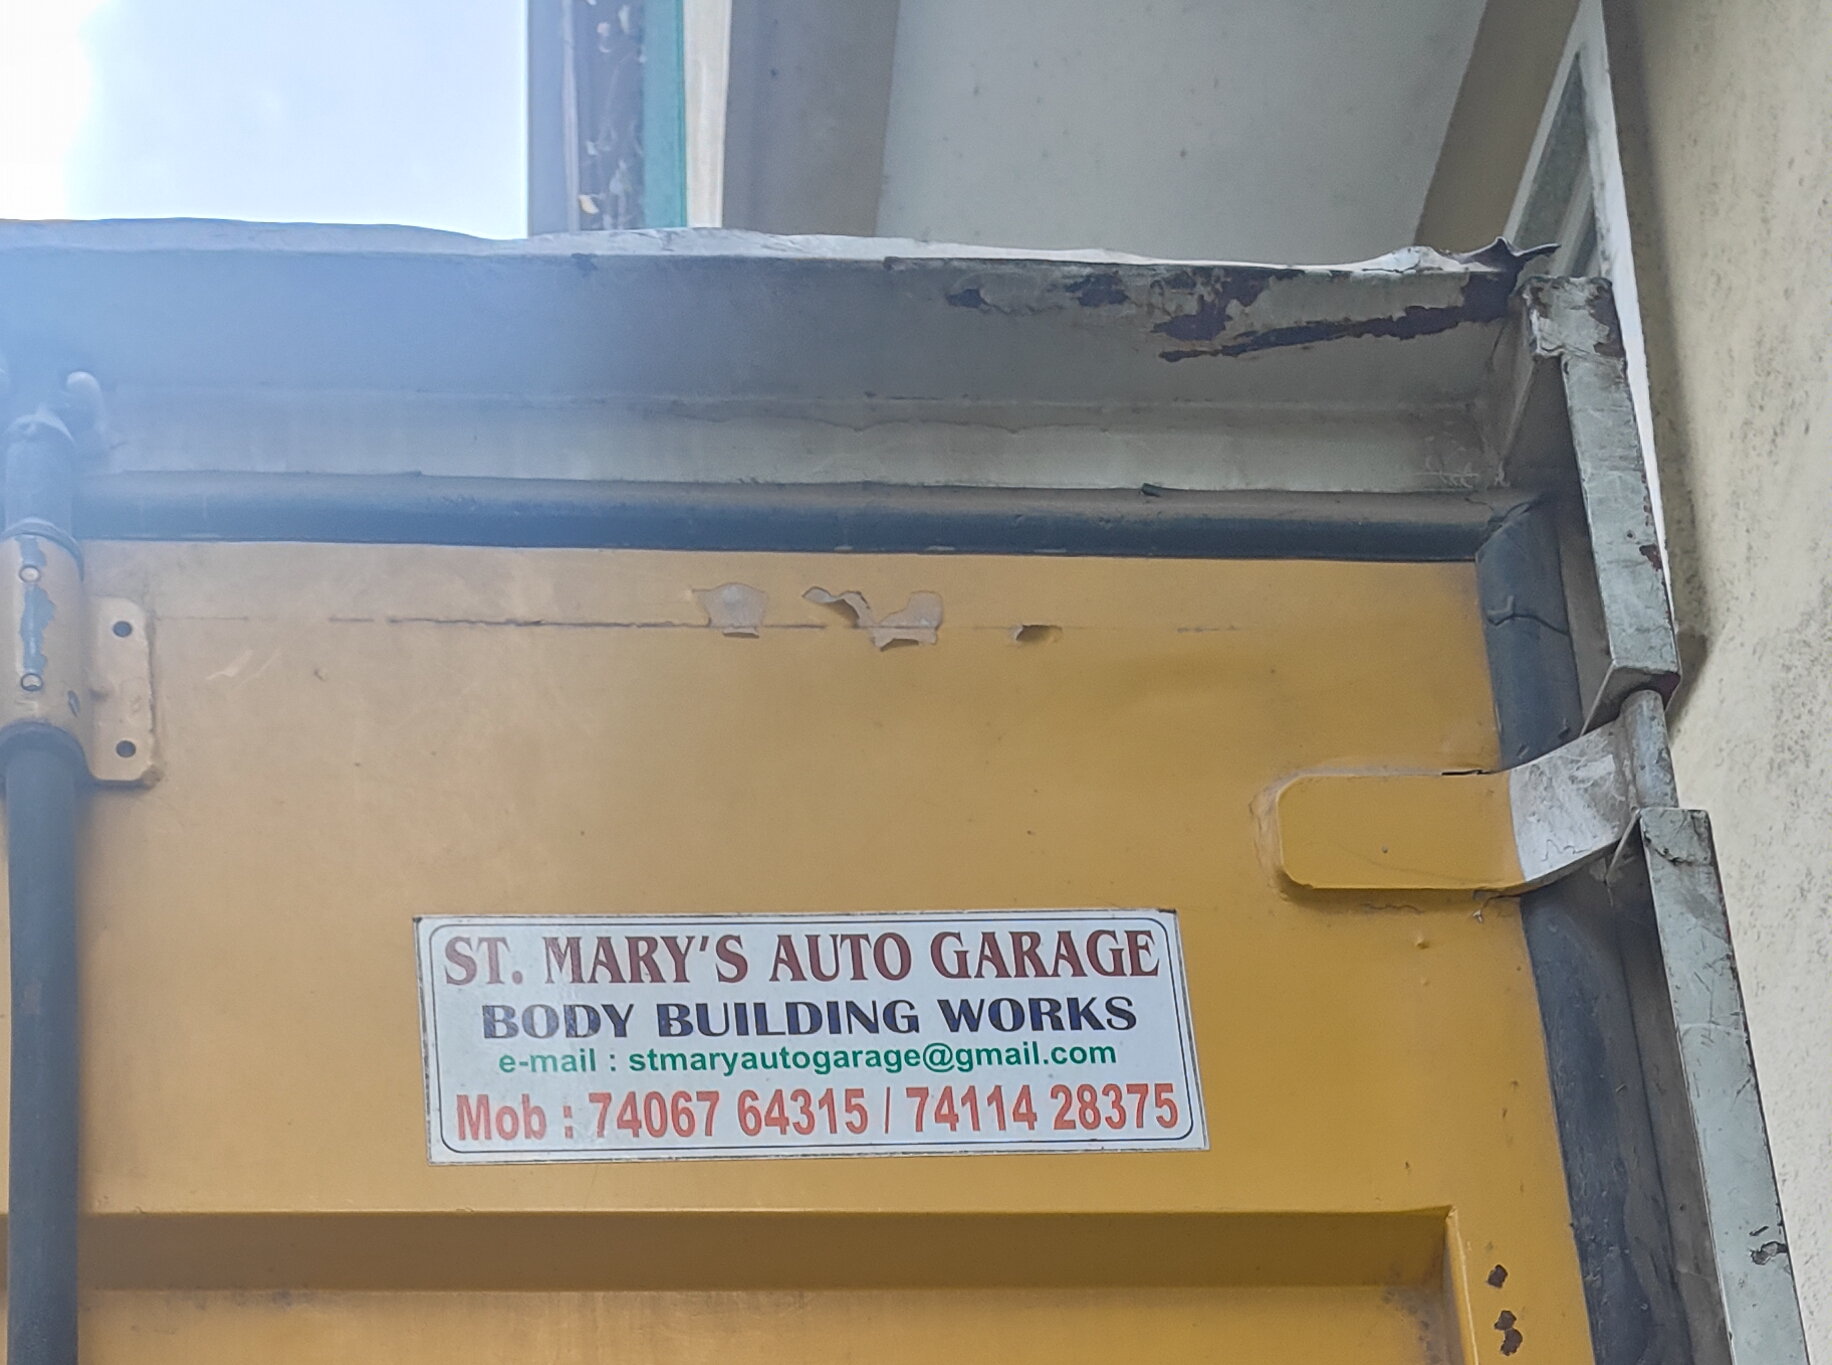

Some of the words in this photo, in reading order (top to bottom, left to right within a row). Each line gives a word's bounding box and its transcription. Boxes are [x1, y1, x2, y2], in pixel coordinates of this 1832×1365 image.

[444, 935, 523, 985] ST.
[543, 935, 750, 984] MARY'S
[768, 932, 912, 982] AUTO
[930, 929, 1161, 979] GARAGE
[482, 1003, 635, 1039] BODY
[656, 999, 920, 1038] BUILDING
[936, 995, 1137, 1033] WORKS
[498, 1047, 597, 1074] e-mail
[627, 1040, 1117, 1077] stmaryautogarage@gmail.com
[456, 1093, 546, 1141] Mob
[588, 1091, 721, 1138] 74067
[738, 1088, 868, 1135] 64315
[905, 1085, 1037, 1132] 74114
[1050, 1083, 1180, 1129] 28375
